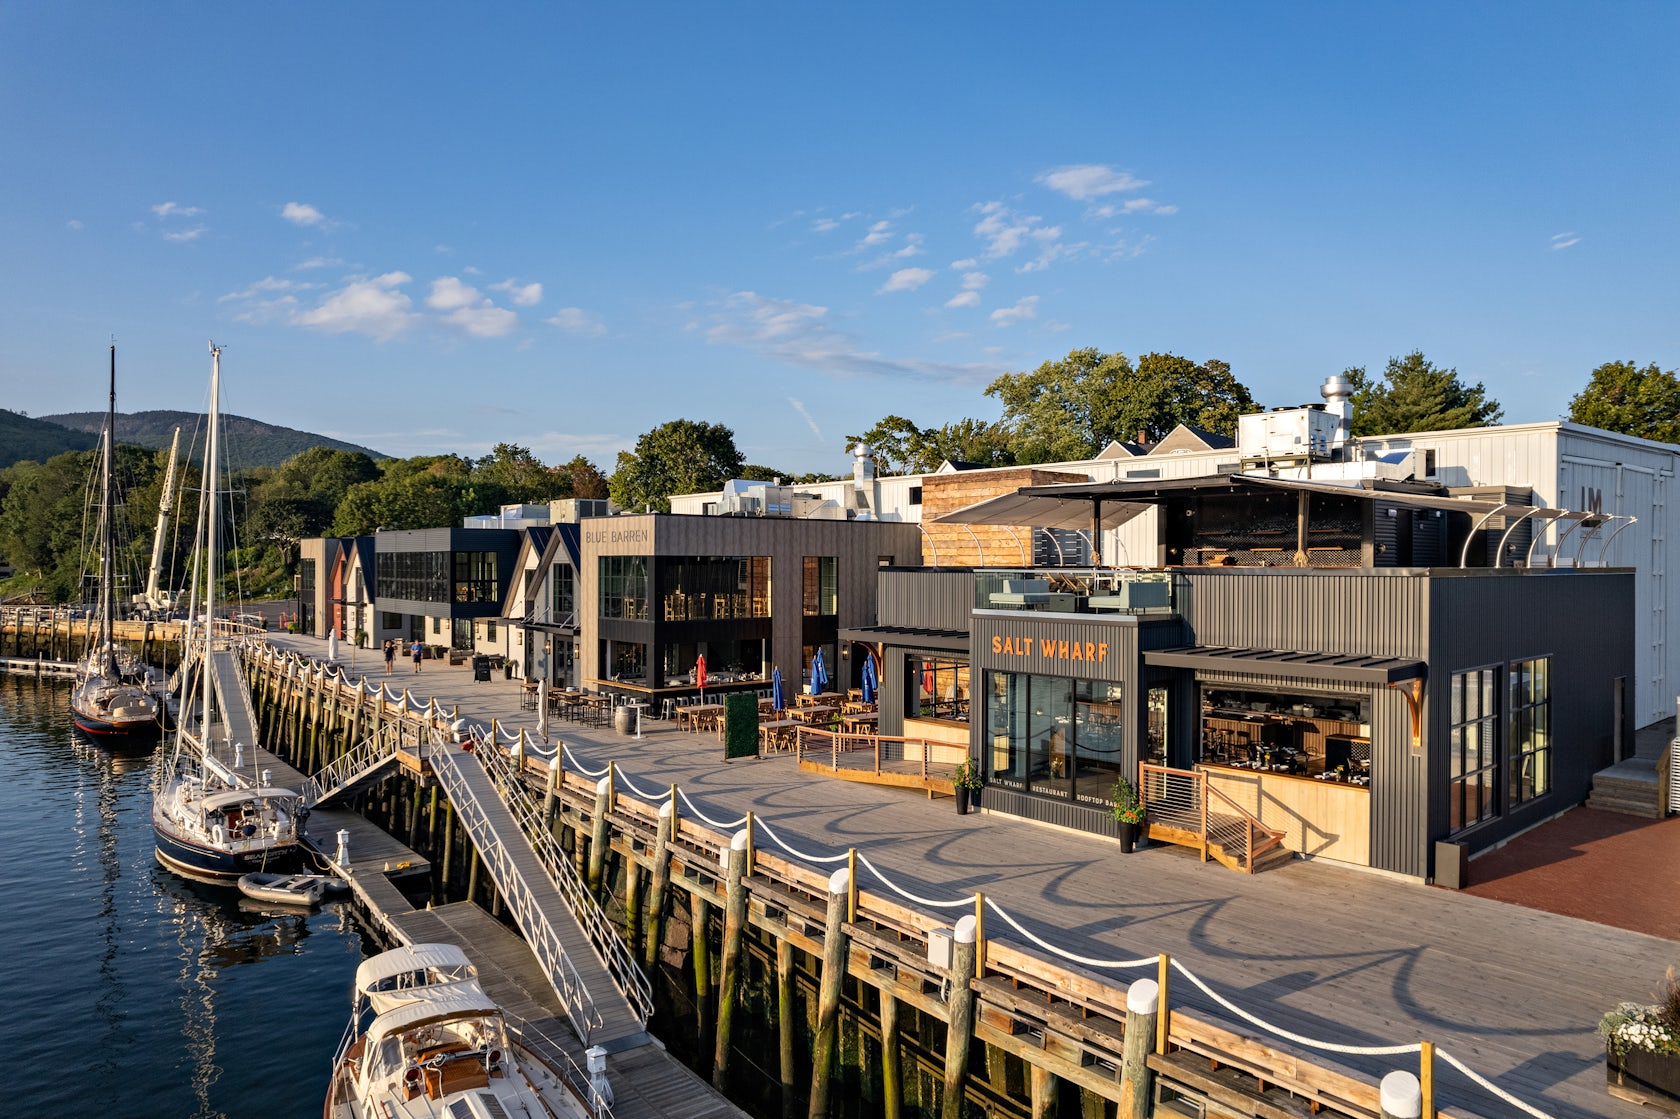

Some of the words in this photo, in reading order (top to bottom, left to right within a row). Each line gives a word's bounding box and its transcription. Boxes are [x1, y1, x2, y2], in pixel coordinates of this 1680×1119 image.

[586, 531, 606, 544] BLUE
[611, 529, 648, 543] BARREN
[992, 635, 1033, 656] SALT
[1041, 639, 1109, 663] WHARF
[989, 777, 1003, 785] SALT
[1004, 779, 1023, 789] WHARF
[1032, 785, 1068, 798] RESTAURANT
[1076, 793, 1104, 805] ROOFTOP
